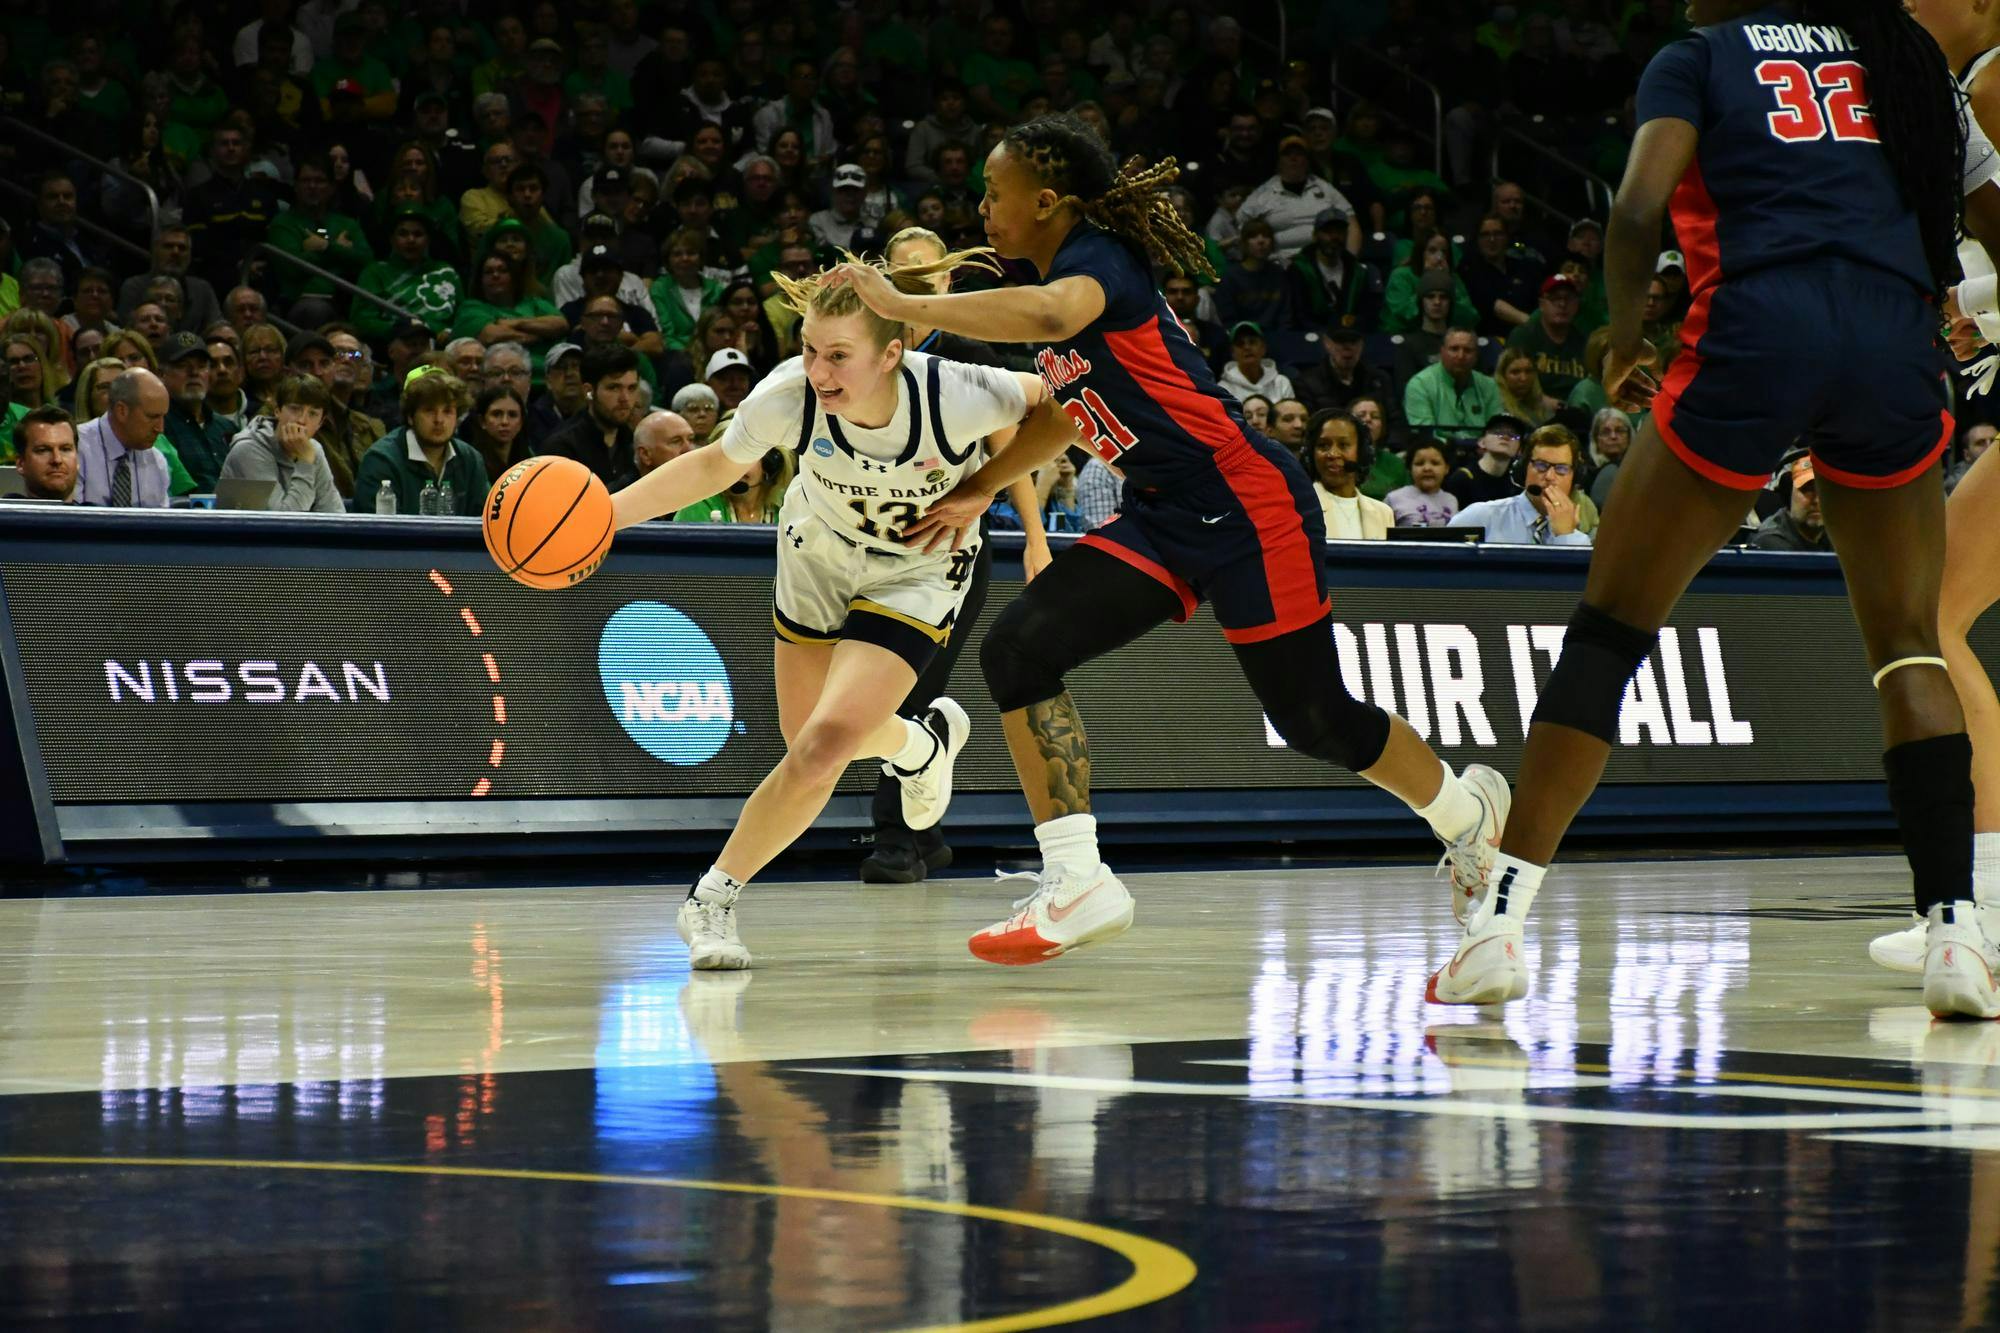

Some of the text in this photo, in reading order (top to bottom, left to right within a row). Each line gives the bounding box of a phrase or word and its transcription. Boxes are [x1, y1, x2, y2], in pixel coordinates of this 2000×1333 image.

[1754, 60, 1881, 143] 32
[1038, 346, 1091, 390] Miss
[1062, 387, 1140, 464] 21
[812, 470, 951, 498] NOTRE DAME
[847, 498, 920, 543] 13
[103, 659, 390, 702] NISSAN
[620, 682, 733, 721] NCAA
[1618, 627, 1754, 745] ALL
